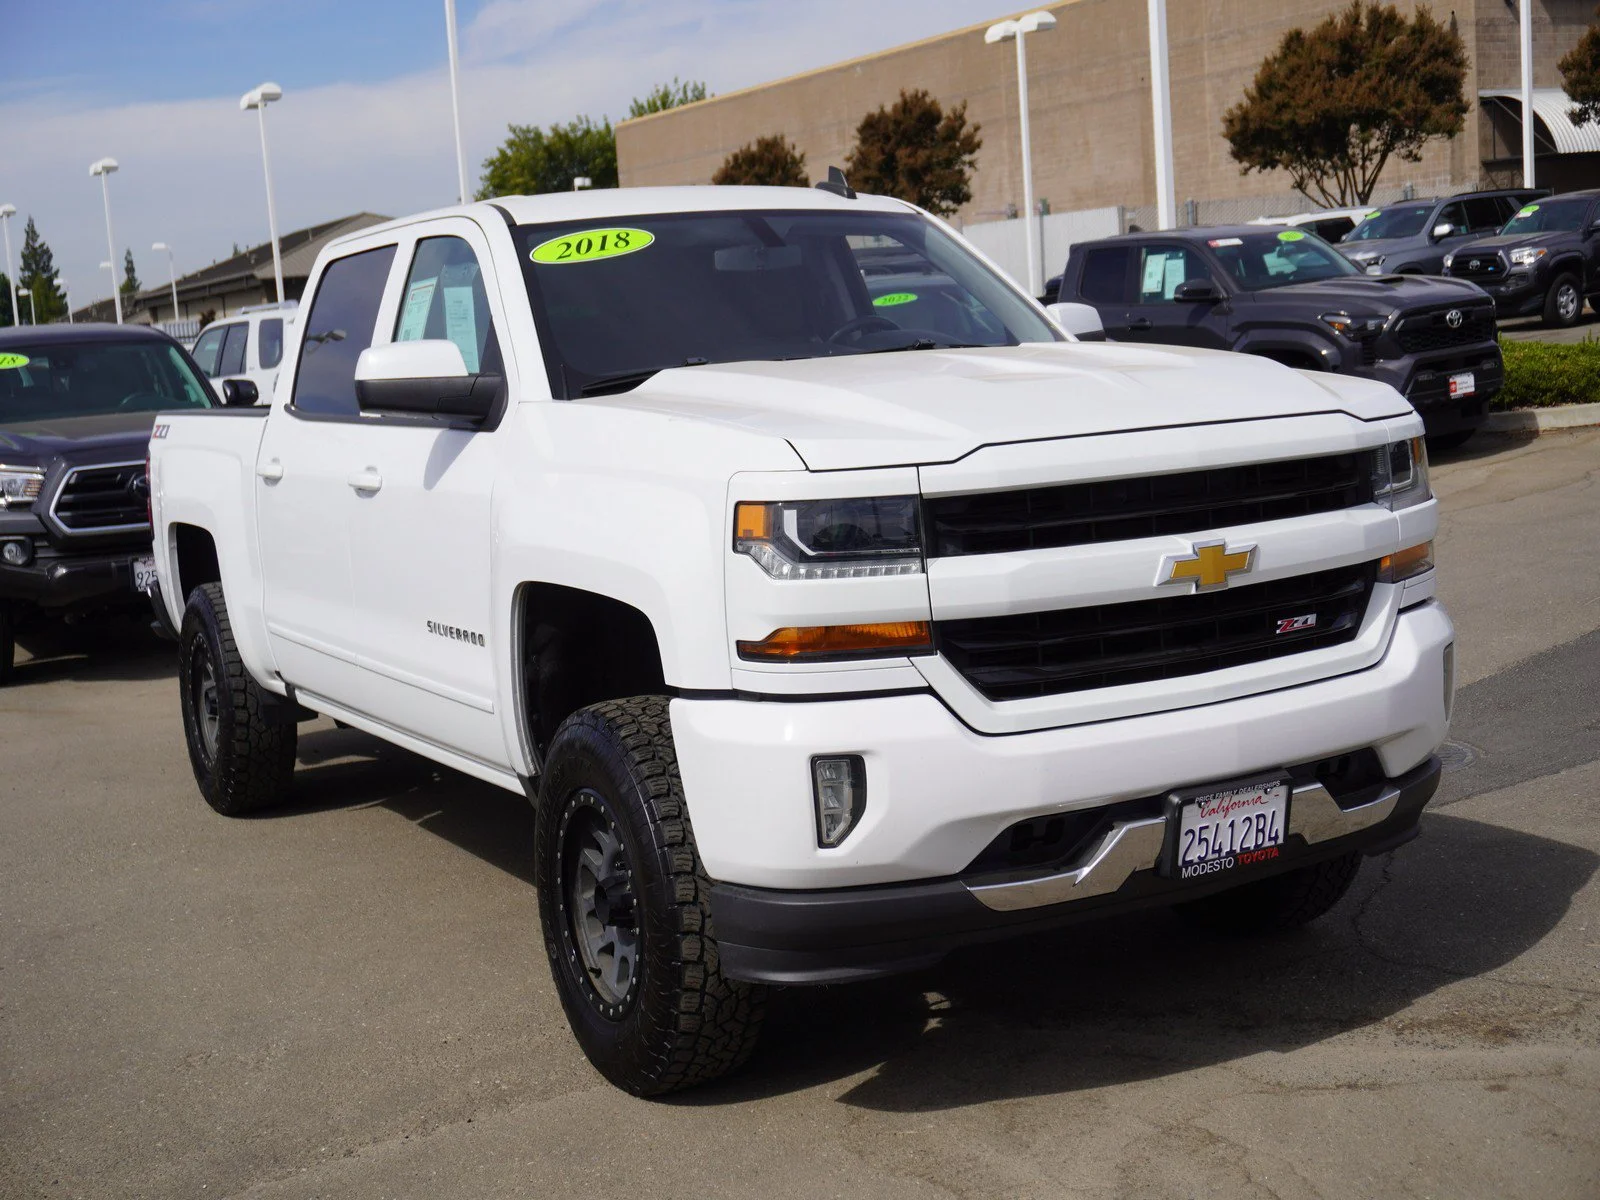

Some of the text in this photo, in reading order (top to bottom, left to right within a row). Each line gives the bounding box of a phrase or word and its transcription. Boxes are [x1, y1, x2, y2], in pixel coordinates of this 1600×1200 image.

[556, 231, 630, 260] 2018
[426, 620, 486, 648] SILVERADO
[1276, 613, 1317, 634] Z71
[1195, 781, 1281, 803] PRICE FAMILY DEALERSHIPS
[1200, 794, 1270, 819] California
[1181, 810, 1280, 867] 25412B4
[1181, 847, 1279, 879] MODESTO TOYOTA
